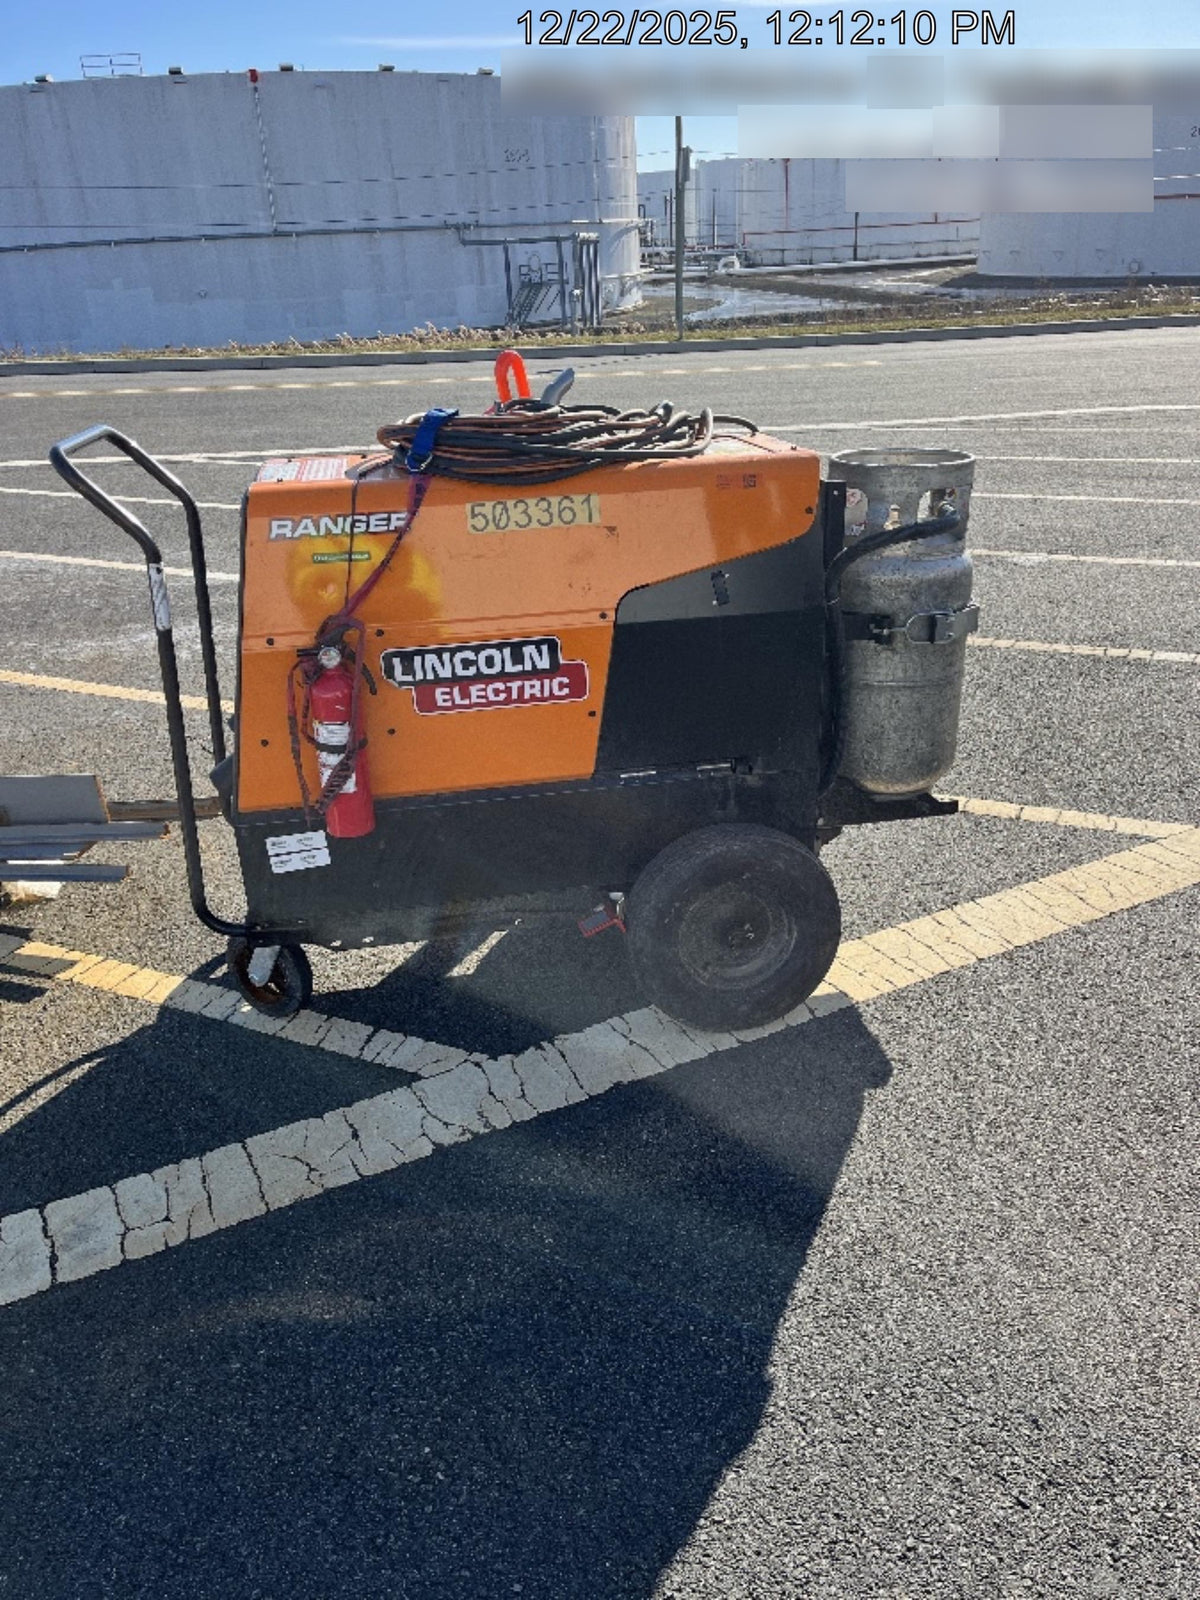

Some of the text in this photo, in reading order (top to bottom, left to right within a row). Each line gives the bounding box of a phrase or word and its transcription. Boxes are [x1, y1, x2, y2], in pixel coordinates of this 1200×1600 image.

[469, 493, 594, 532] 503361
[392, 643, 551, 683] LINCOLN
[435, 676, 571, 707] ELECTRIC
